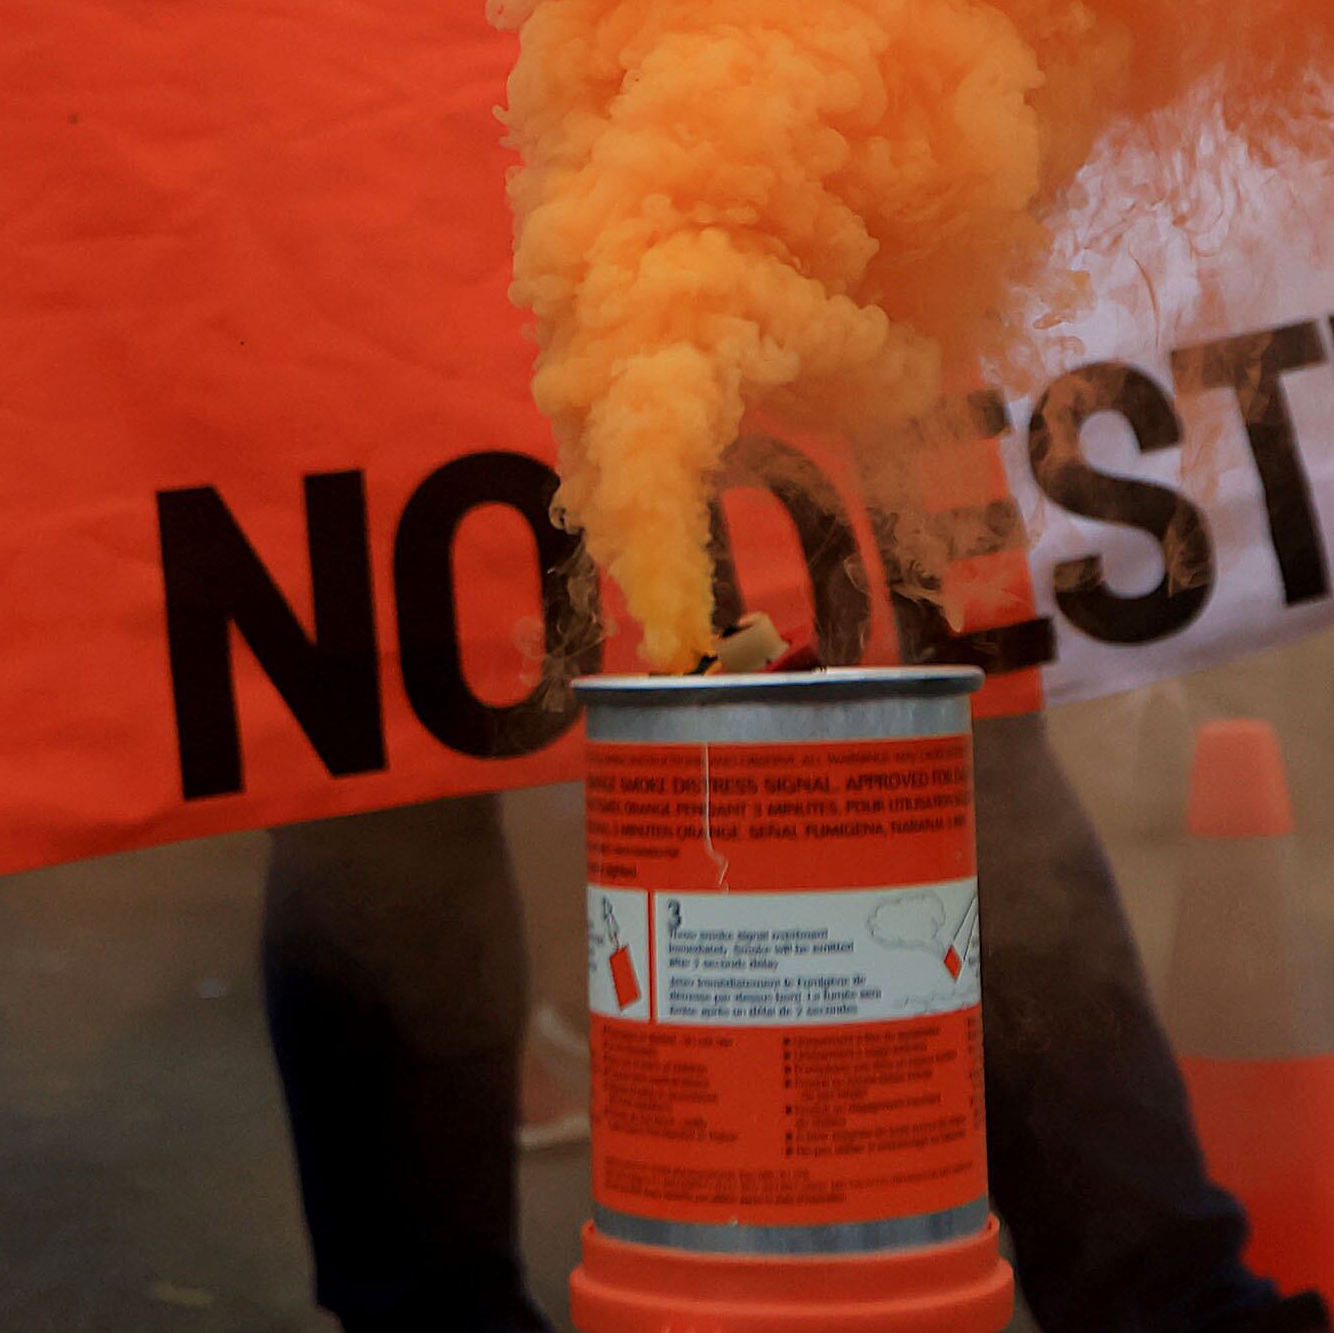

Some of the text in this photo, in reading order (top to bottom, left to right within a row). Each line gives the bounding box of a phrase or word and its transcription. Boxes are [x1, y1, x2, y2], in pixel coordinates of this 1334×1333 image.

[157, 451, 607, 800] NO
[673, 776, 758, 794] DISTRESS
[846, 772, 929, 791] APPROVED
